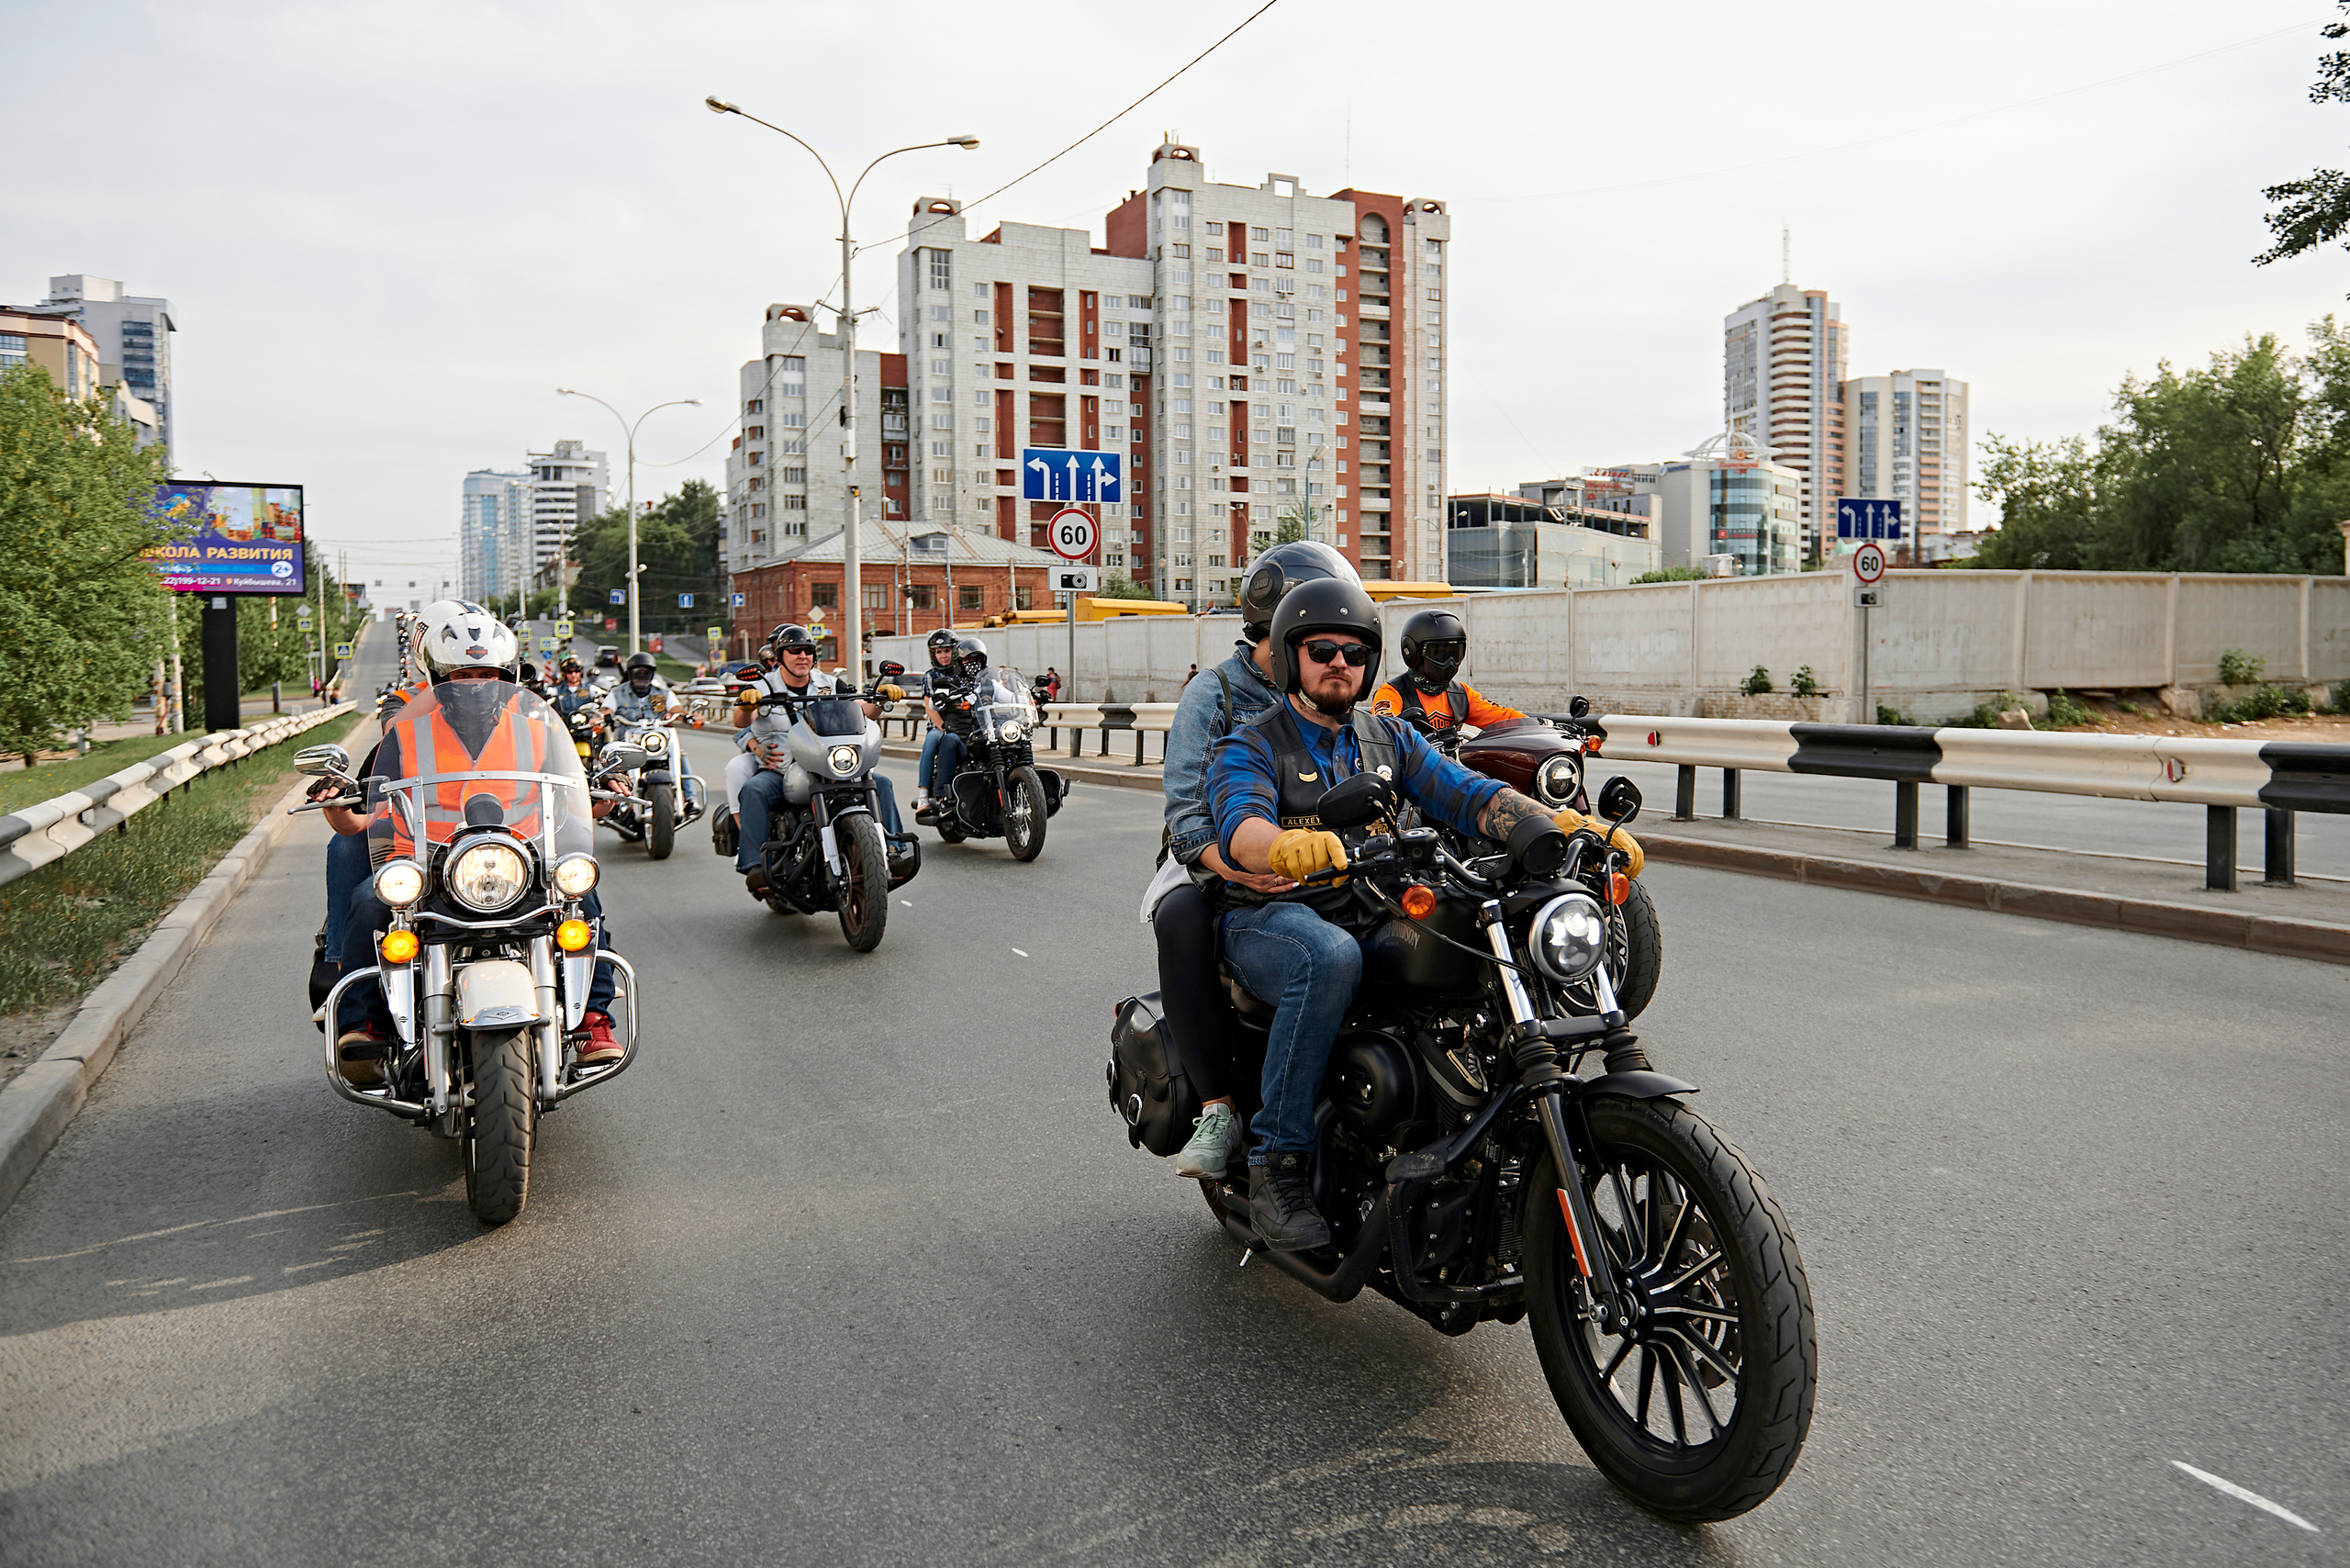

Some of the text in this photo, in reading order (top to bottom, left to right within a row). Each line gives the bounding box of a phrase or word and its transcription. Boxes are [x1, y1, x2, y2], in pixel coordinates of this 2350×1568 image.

[1060, 525, 1087, 545] 60
[207, 546, 293, 560] РАЗВИТИЯ
[1862, 555, 1879, 571] 60
[274, 564, 290, 574] 2+
[160, 577, 221, 586] 22)199-12-21
[233, 577, 297, 587] Куйбышева, 21
[1429, 716, 1450, 729] OTOR
[1287, 816, 1321, 825] ALEXEY
